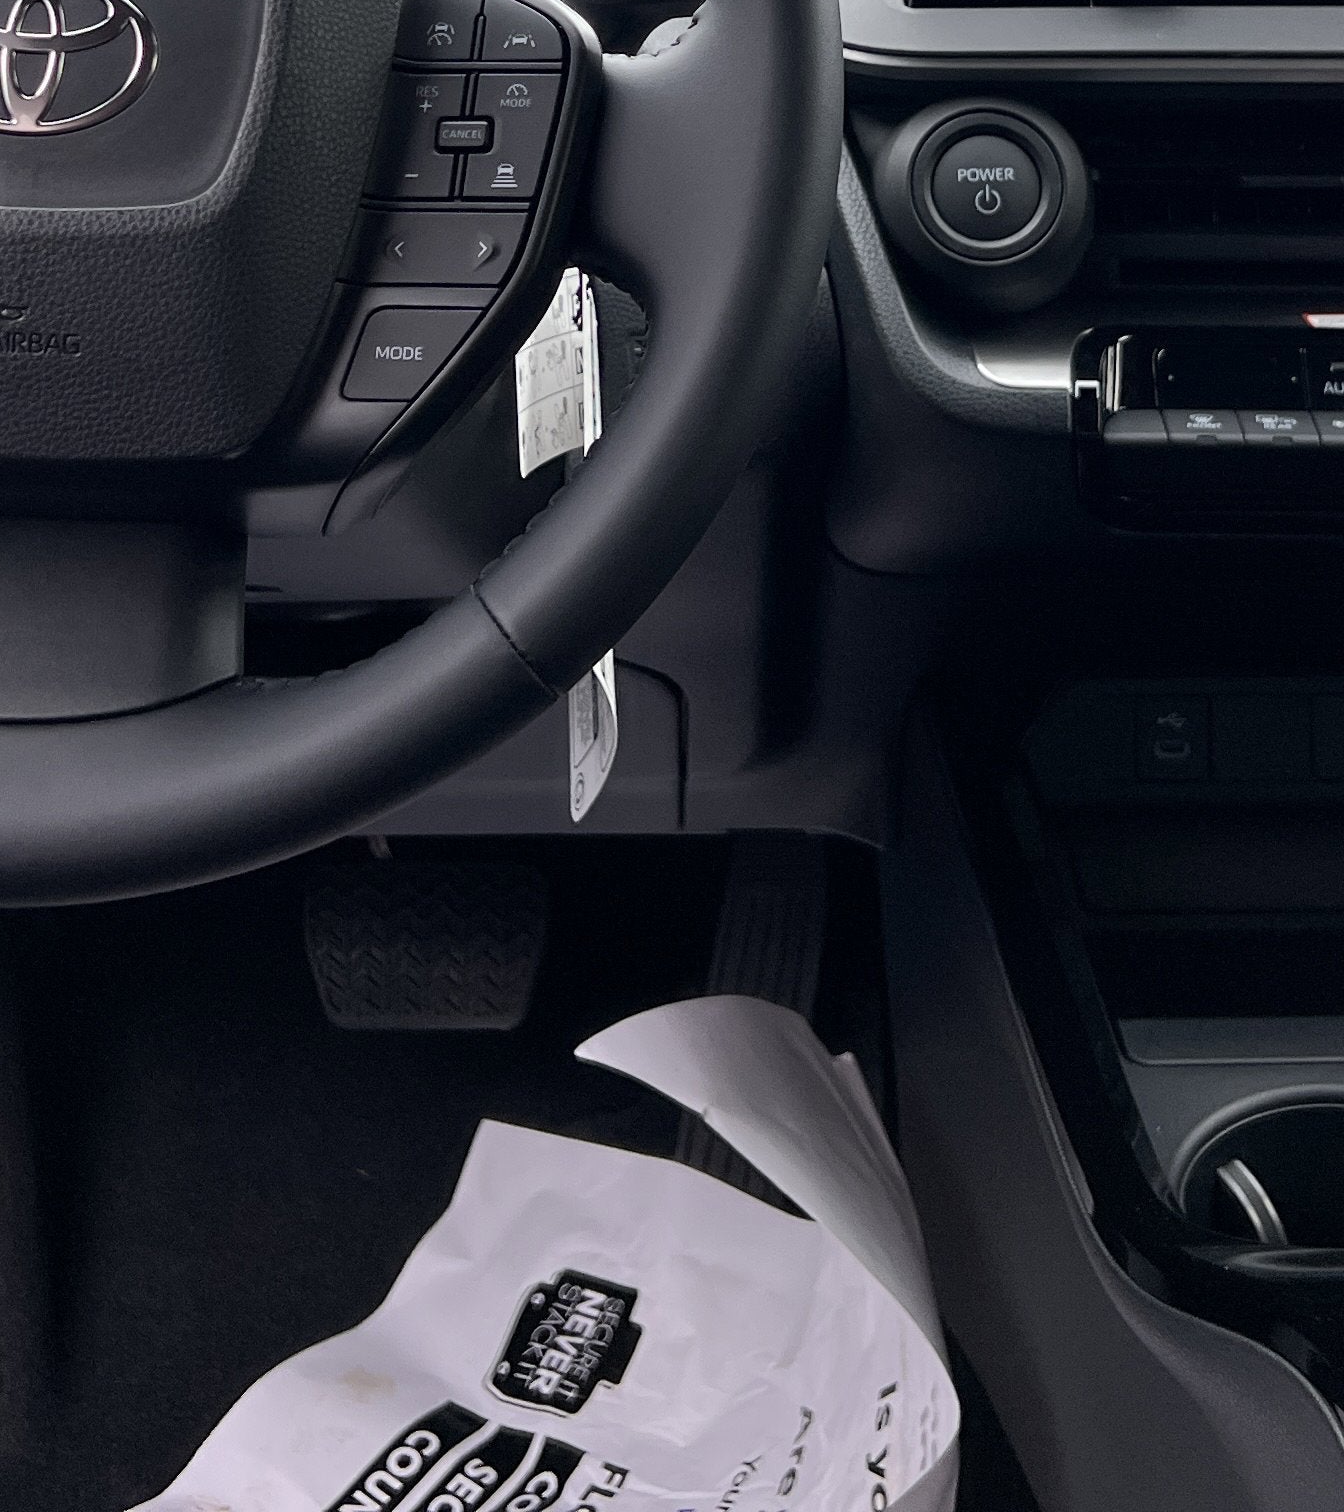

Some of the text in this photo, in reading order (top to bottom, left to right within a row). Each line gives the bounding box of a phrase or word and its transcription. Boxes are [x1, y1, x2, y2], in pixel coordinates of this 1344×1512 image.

[415, 86, 439, 99] RES
[500, 98, 532, 109] MODE
[441, 128, 483, 140] CANCEL
[957, 167, 1015, 182] POWER
[375, 345, 423, 361] MODE
[522, 1283, 582, 1359] STACK
[529, 1288, 607, 1395] NEVER
